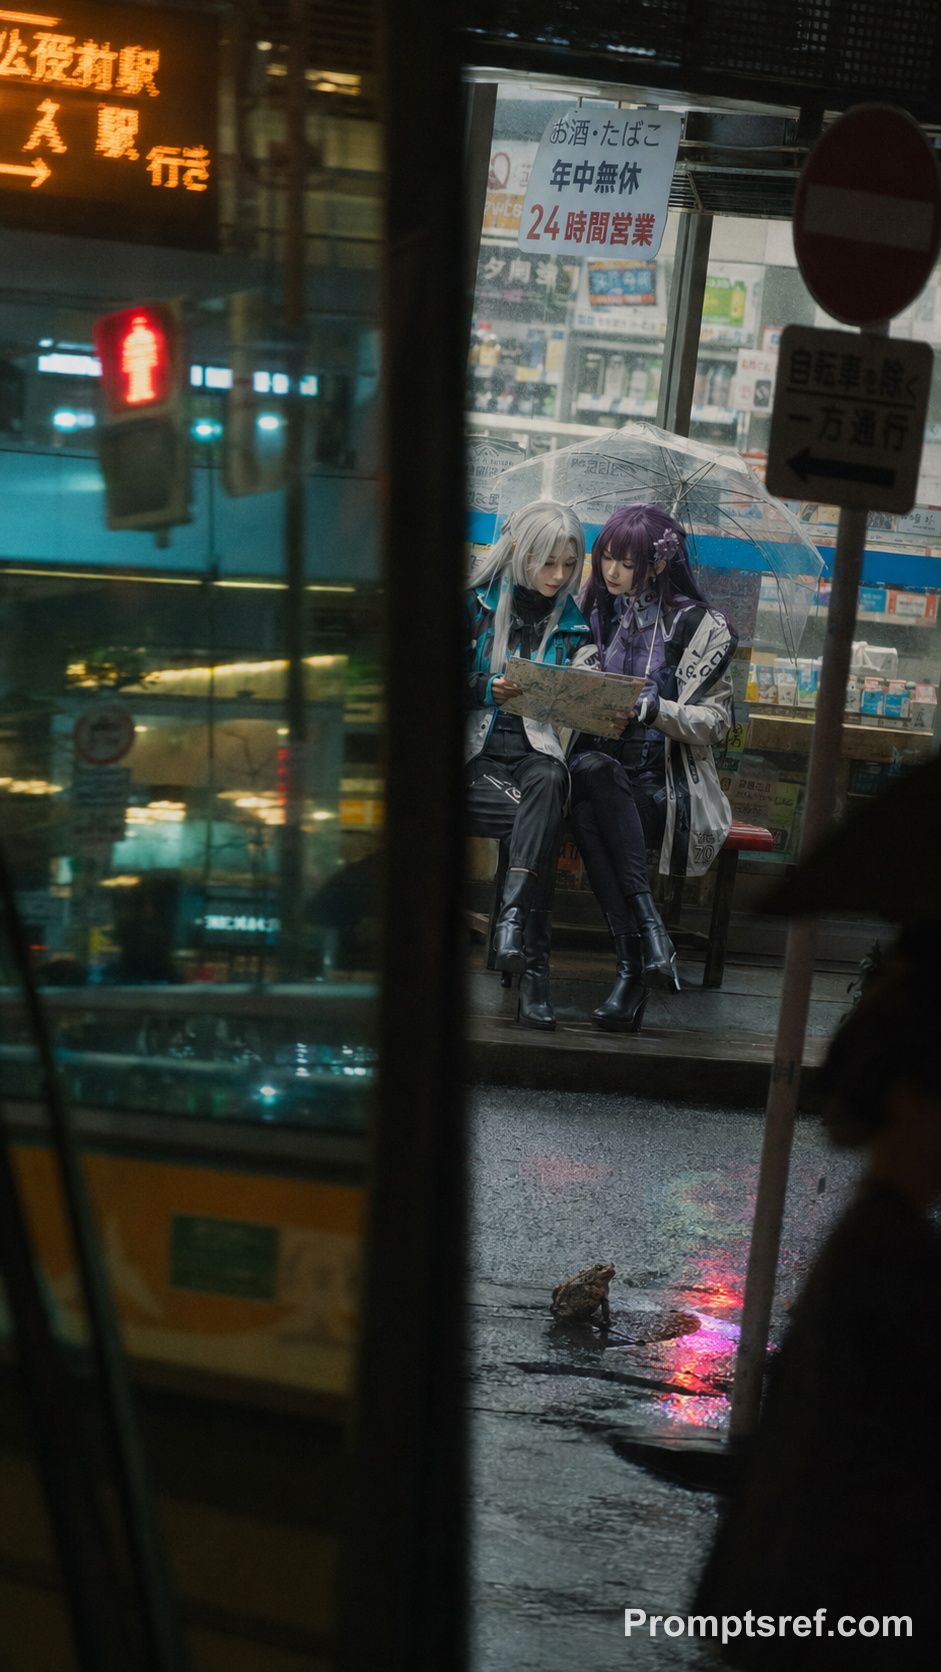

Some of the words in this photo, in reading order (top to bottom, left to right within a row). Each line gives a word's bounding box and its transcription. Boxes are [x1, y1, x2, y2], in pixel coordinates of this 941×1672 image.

[549, 118, 662, 147] お酒・たばこ
[549, 158, 643, 196] 年中無休
[788, 348, 919, 400] 自転車を除く
[788, 402, 910, 453] 一方通行
